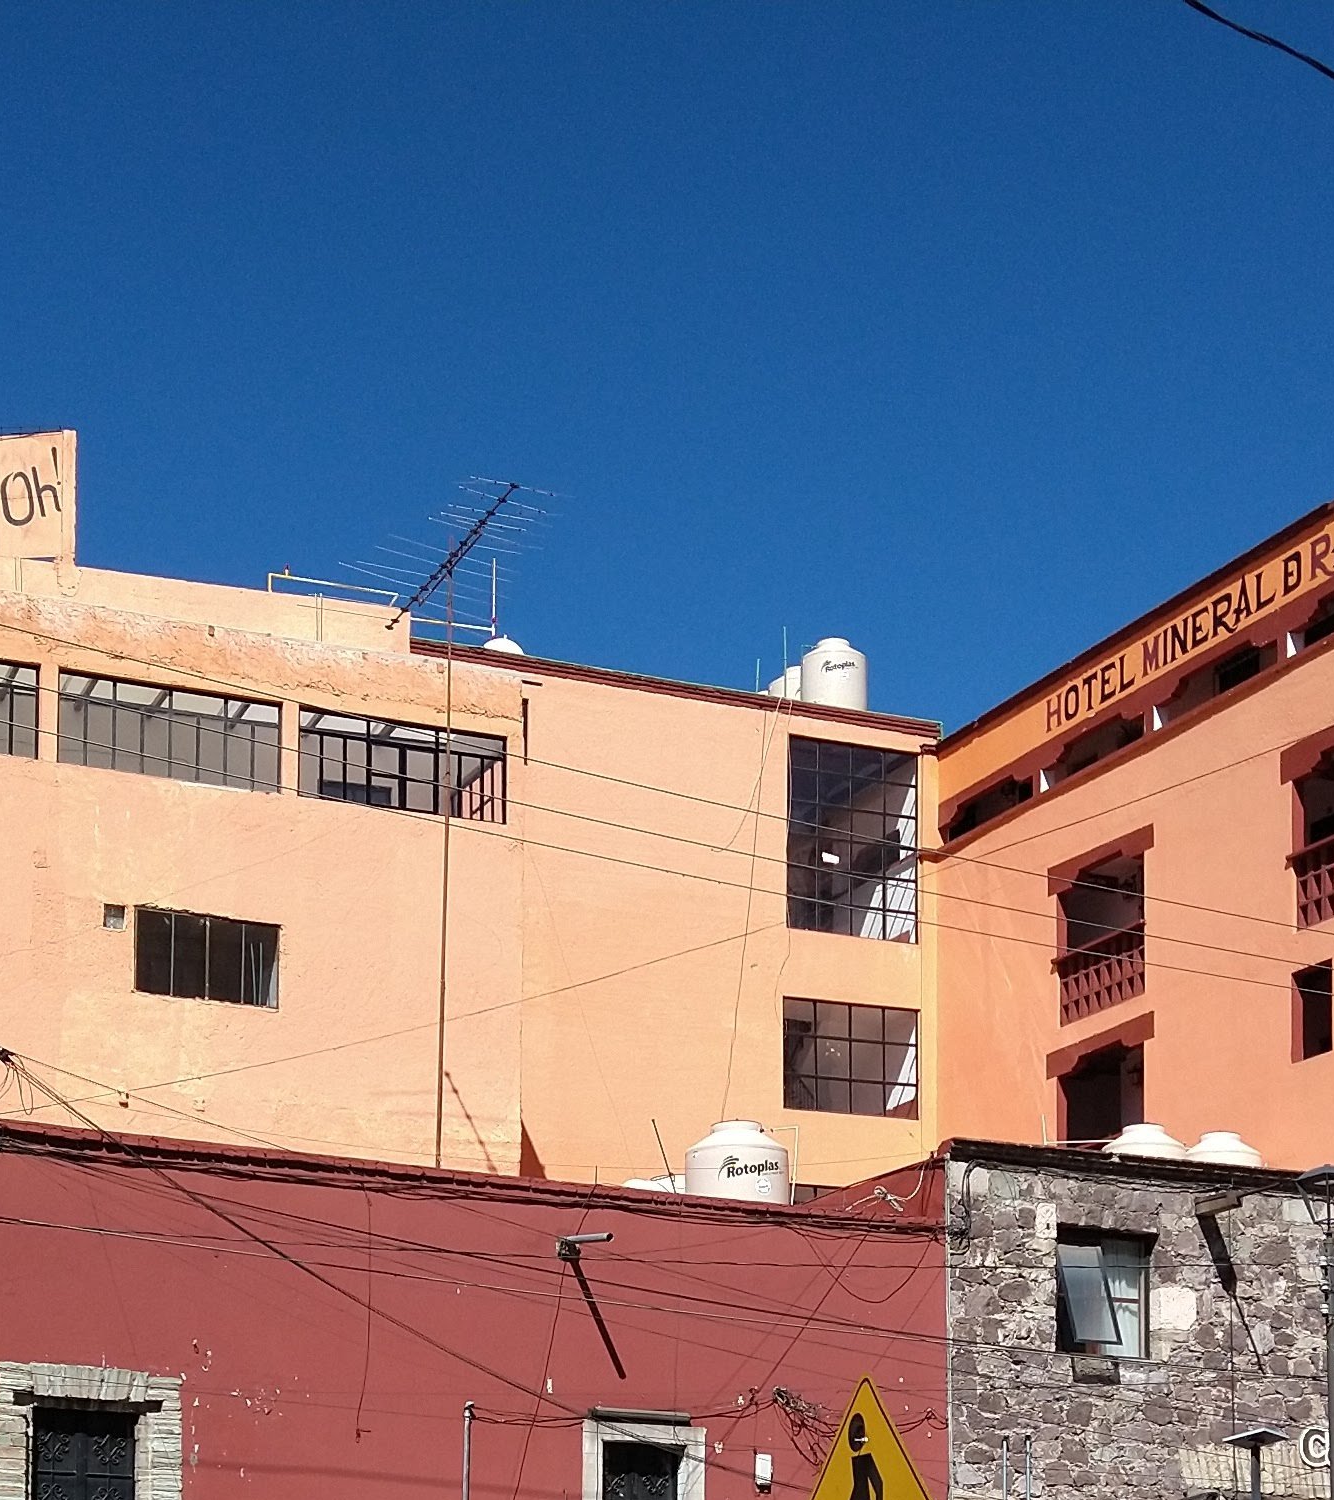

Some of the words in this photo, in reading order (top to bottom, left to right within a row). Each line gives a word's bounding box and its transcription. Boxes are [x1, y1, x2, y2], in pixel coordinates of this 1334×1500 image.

[1045, 653, 1137, 733] HOTEL
[1142, 575, 1278, 679] MINERAL
[727, 1160, 779, 1178] Rotoplas
